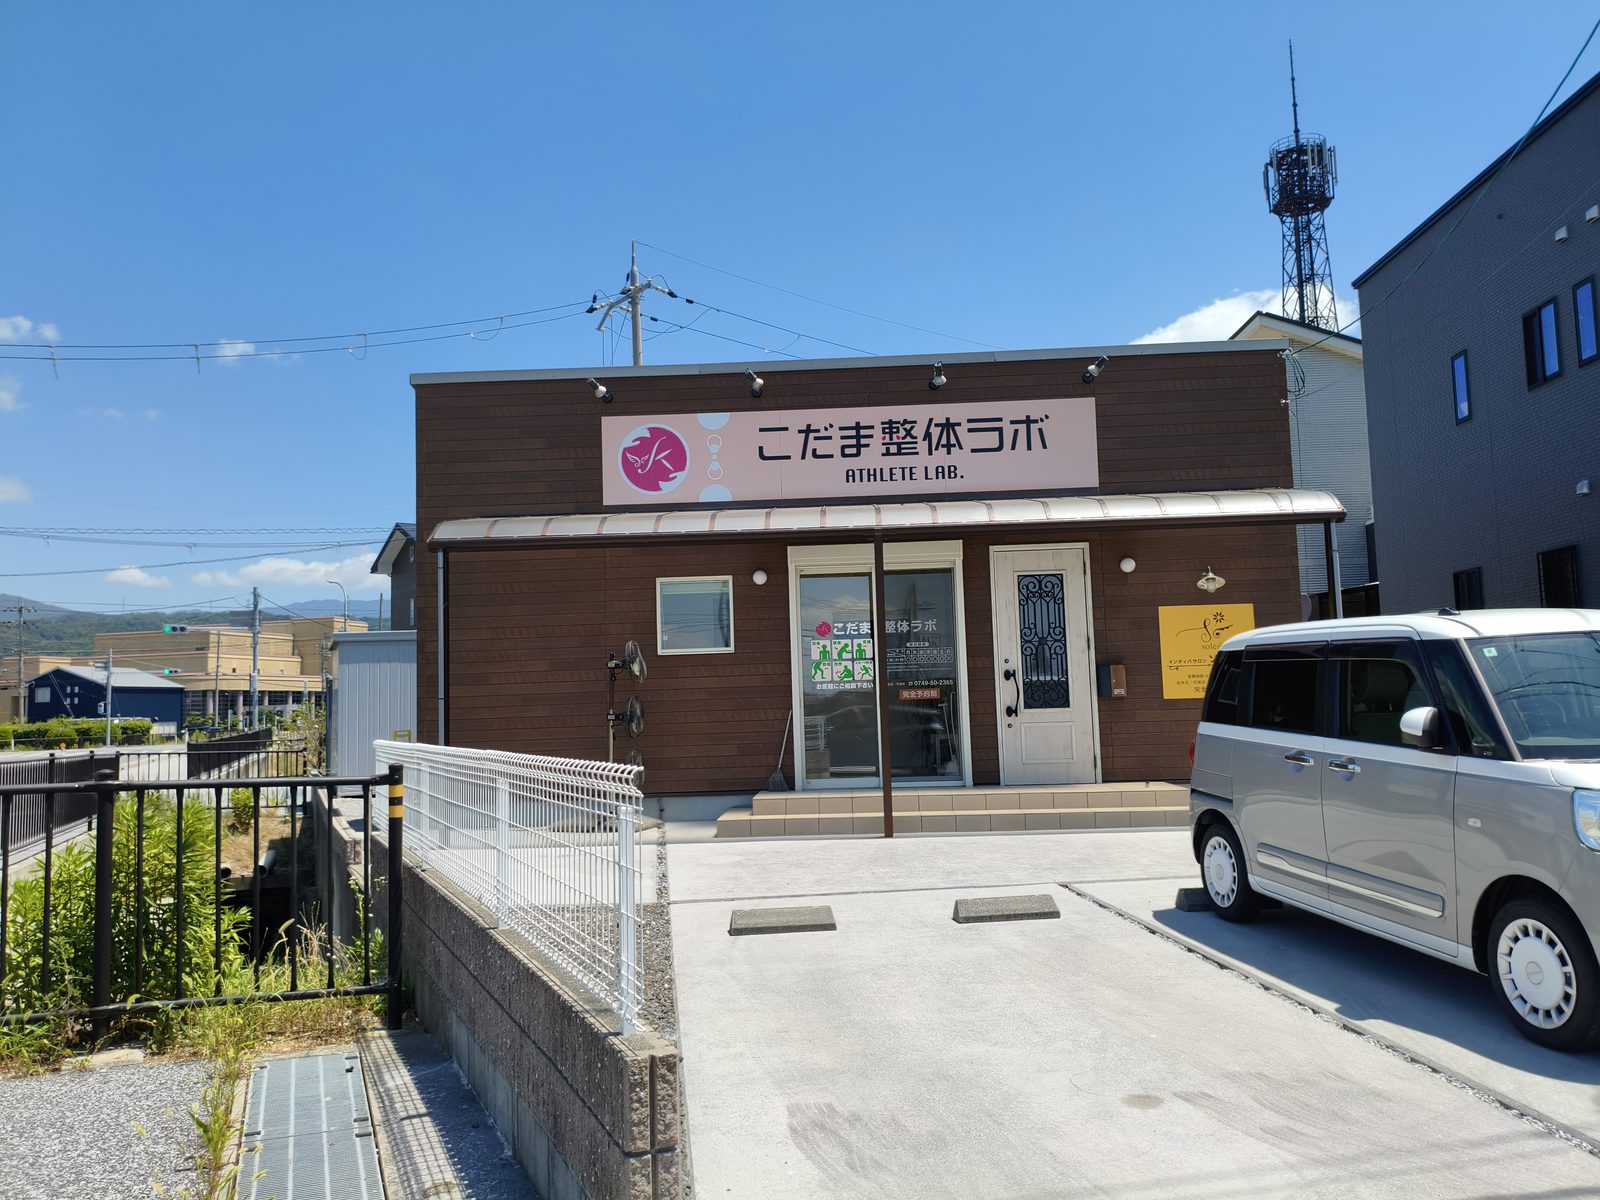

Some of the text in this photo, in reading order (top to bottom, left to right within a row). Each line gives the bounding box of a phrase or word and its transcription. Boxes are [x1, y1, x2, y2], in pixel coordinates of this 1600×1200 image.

[757, 413, 1050, 461] こだま整体ラボ
[845, 464, 964, 484] ATHLETE LAB.
[833, 621, 872, 635] こだま
